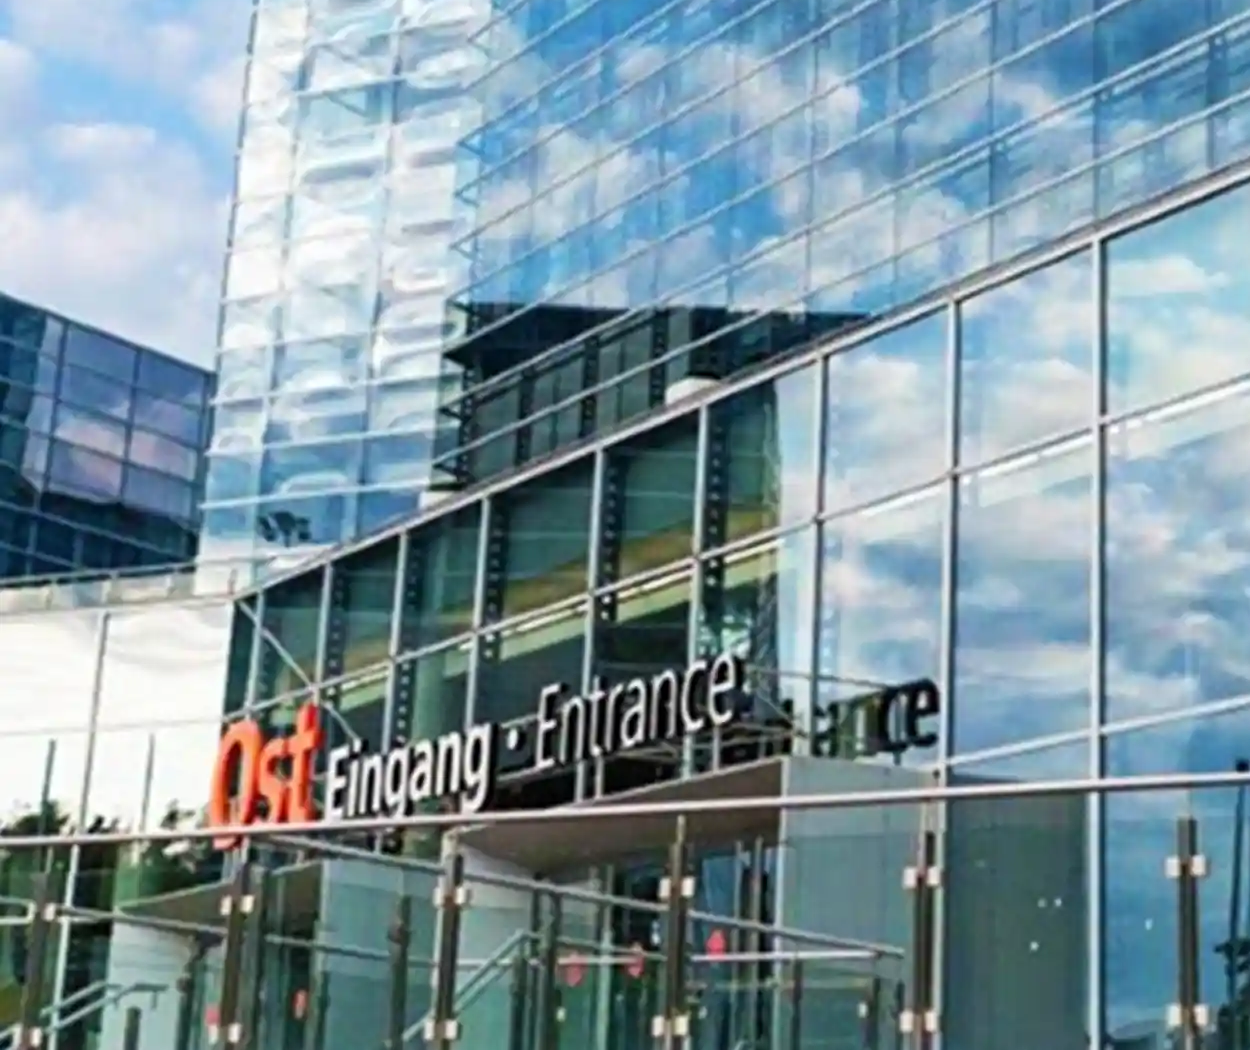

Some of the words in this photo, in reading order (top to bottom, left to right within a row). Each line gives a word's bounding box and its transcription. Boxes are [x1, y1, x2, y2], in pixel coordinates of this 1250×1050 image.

[207, 702, 326, 850] Ost
[323, 722, 493, 822] Eingang
[534, 651, 737, 769] Entrance
